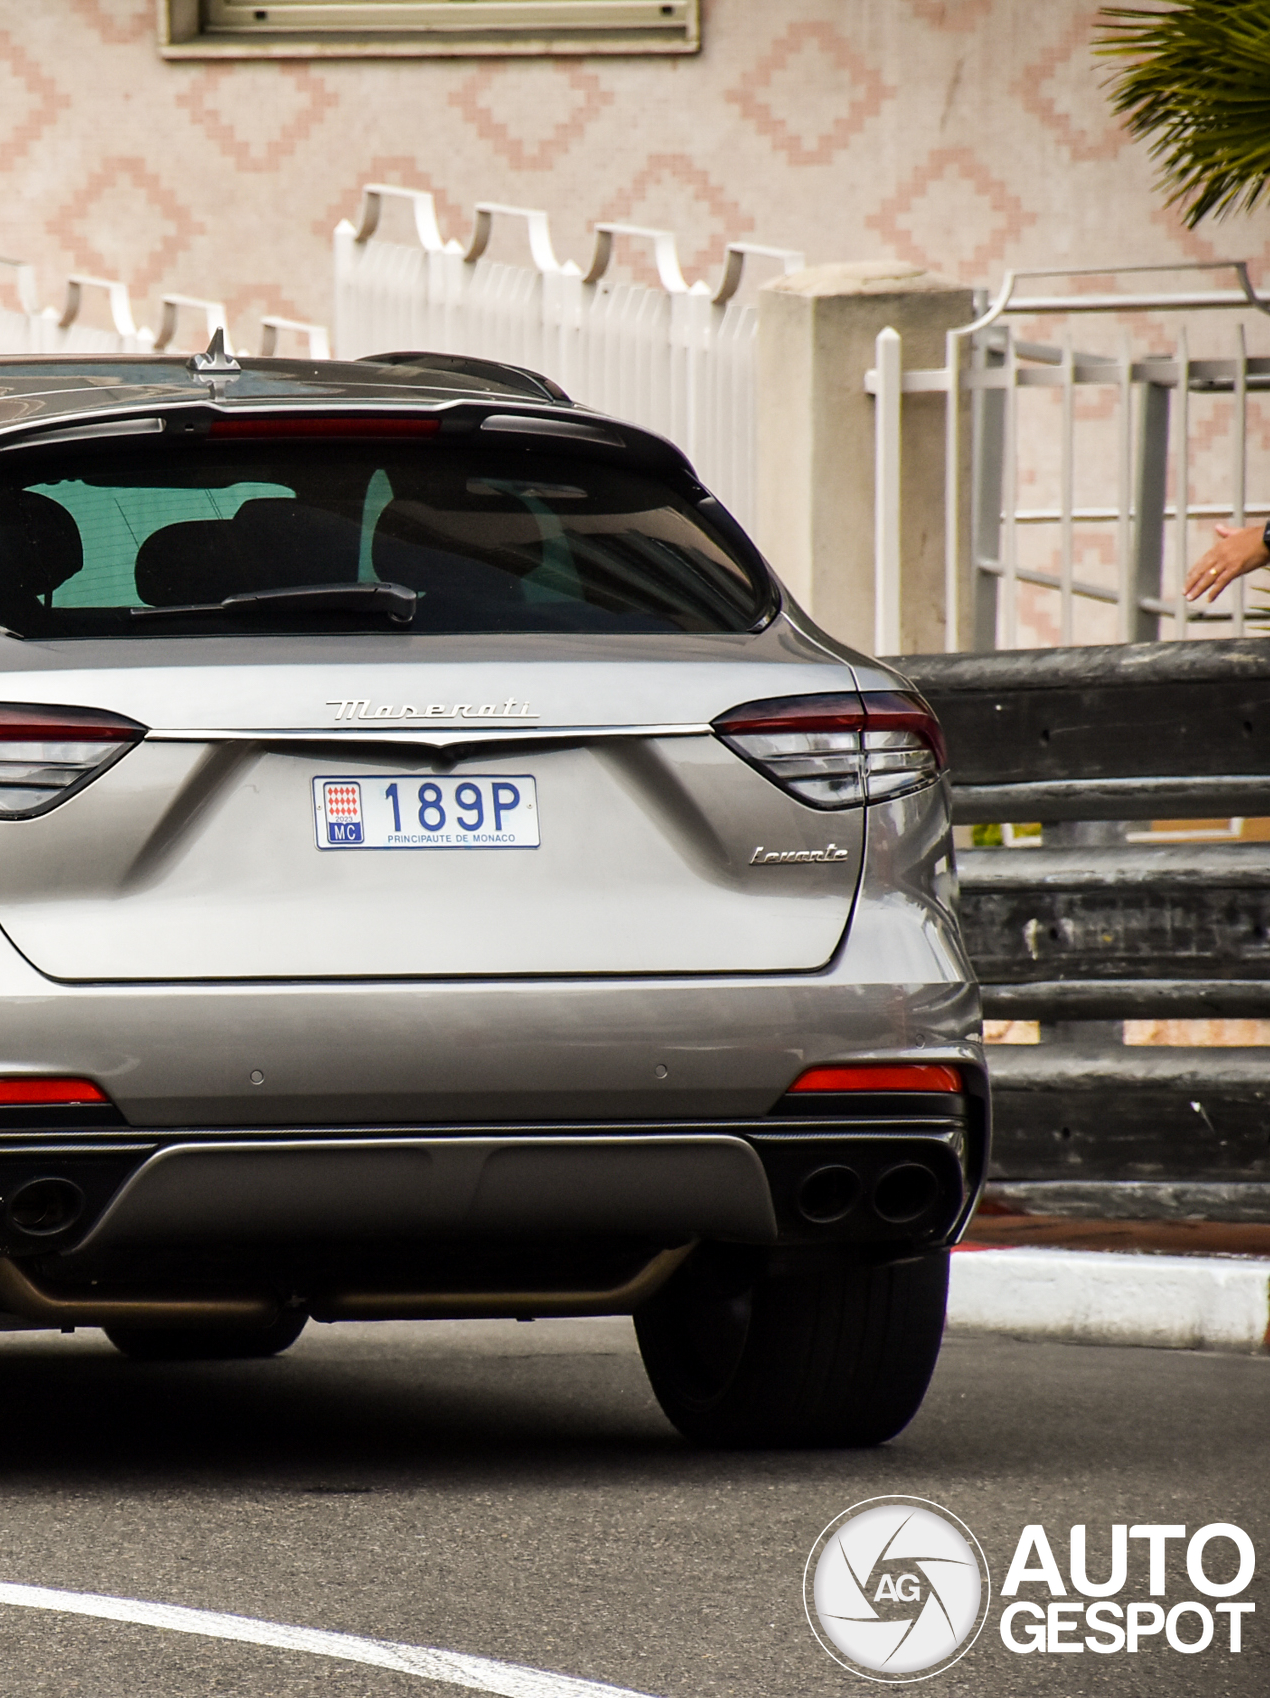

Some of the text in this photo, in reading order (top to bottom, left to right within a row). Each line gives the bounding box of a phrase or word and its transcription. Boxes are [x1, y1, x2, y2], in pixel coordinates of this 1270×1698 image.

[326, 697, 541, 721] Maserati
[385, 782, 520, 832] 189P
[334, 825, 356, 840] MC
[387, 834, 516, 843] PRINCIPAUTE DE MONACO
[749, 843, 849, 865] Levante
